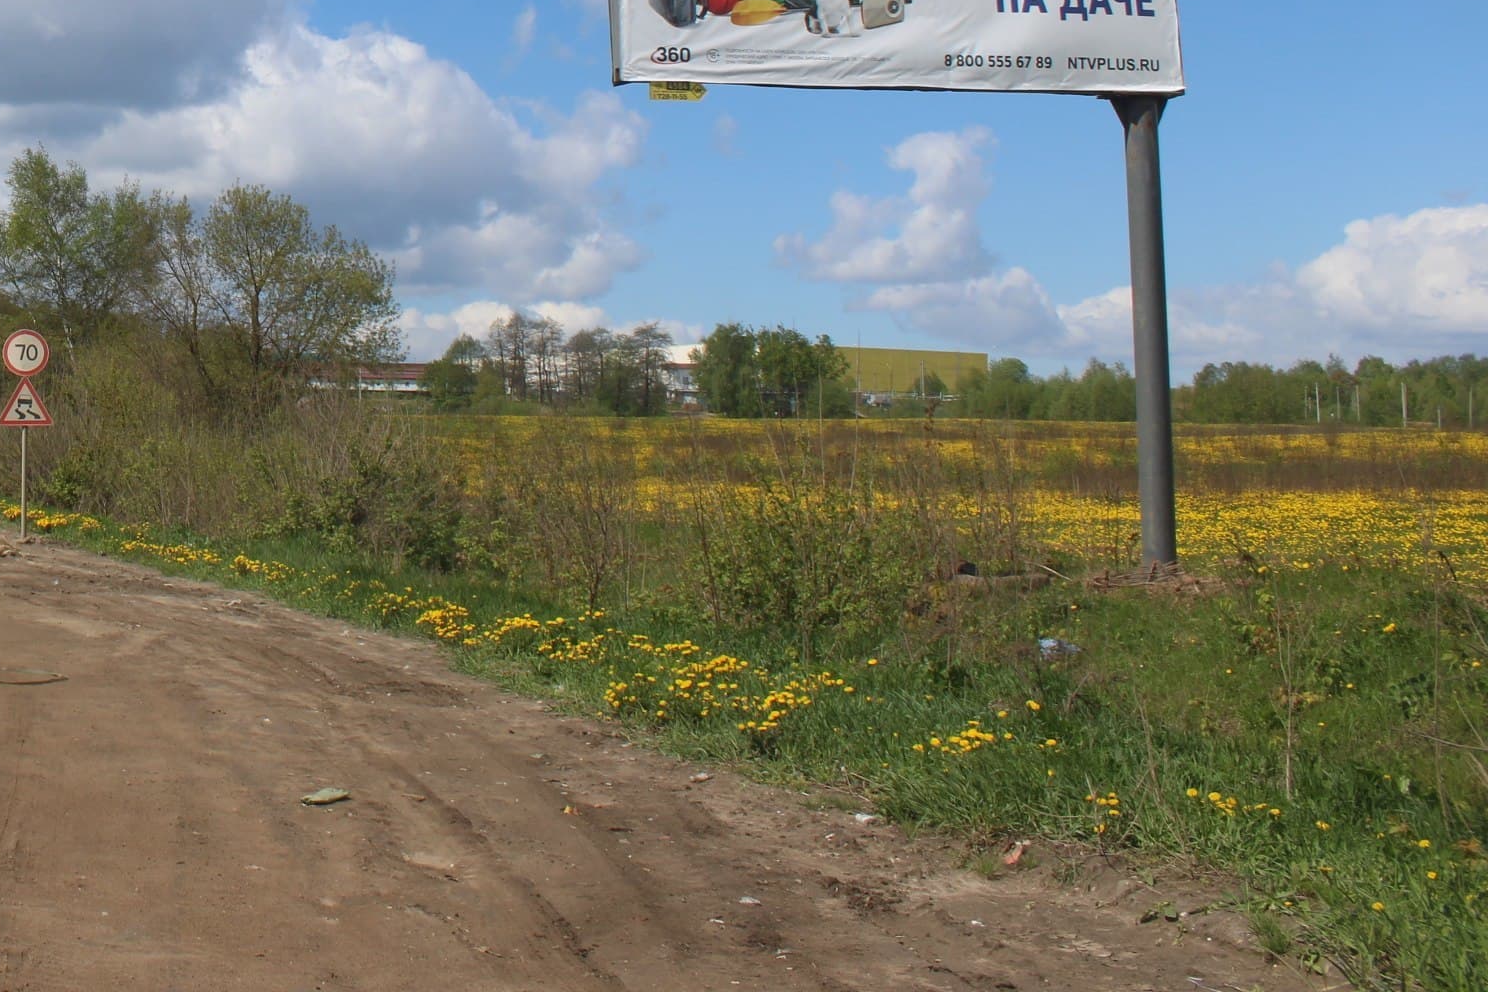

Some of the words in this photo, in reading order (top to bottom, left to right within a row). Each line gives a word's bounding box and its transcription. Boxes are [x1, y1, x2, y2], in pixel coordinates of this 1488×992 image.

[656, 46, 691, 62] 360
[944, 54, 952, 67] 8
[956, 54, 983, 67] 800
[988, 55, 1012, 68] 555
[1016, 56, 1032, 68] 67
[1035, 56, 1052, 69] 89
[1067, 56, 1160, 72] NTVPLUS.RU
[15, 344, 38, 361] 70
